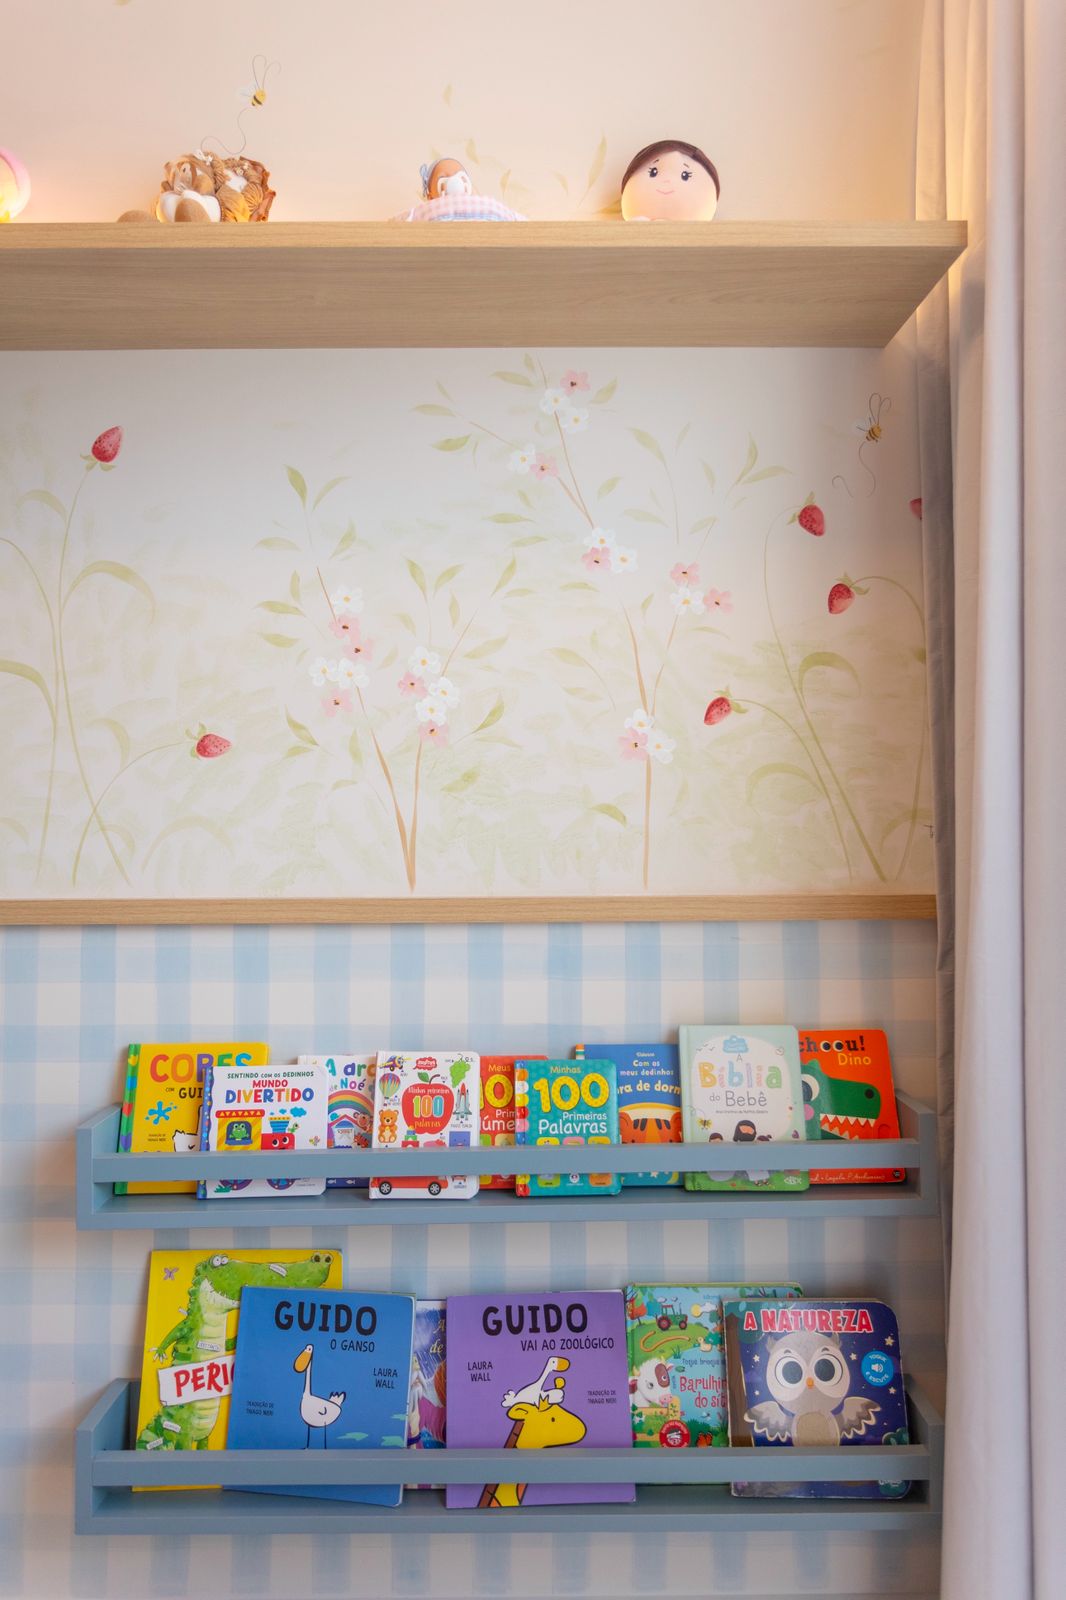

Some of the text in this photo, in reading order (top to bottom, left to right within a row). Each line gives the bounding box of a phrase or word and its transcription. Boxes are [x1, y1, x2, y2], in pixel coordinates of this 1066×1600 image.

[736, 1053, 743, 1062] A
[838, 1053, 872, 1066] Dino
[325, 1058, 336, 1077] A
[488, 1064, 512, 1072] Meus
[550, 1066, 581, 1074] Minhas
[641, 1068, 674, 1076] dedinhos
[252, 1079, 288, 1088] MUNDO
[340, 1077, 366, 1091] Noé
[636, 1080, 650, 1091] de
[225, 1087, 314, 1104] DIVERTIDO
[533, 1073, 610, 1113] 100
[709, 1090, 767, 1107] do Bebê
[412, 1094, 445, 1118] 100
[414, 1118, 441, 1128] palavras
[480, 1115, 515, 1131] úme
[562, 1112, 607, 1121] Primeiras
[538, 1119, 608, 1135] Palavras
[274, 1301, 377, 1336] GUIDO
[482, 1303, 588, 1336] GUIDO
[744, 1309, 874, 1333] A NATUREZA
[330, 1339, 375, 1352] O GANSO
[521, 1335, 615, 1351] VAI AO ZOOLÓGICO
[373, 1367, 398, 1378] LAURA
[467, 1361, 493, 1371] LAURA
[174, 1361, 234, 1398] PERI
[375, 1379, 395, 1389] WALL
[470, 1373, 491, 1382] WALL
[695, 1391, 708, 1408] do
